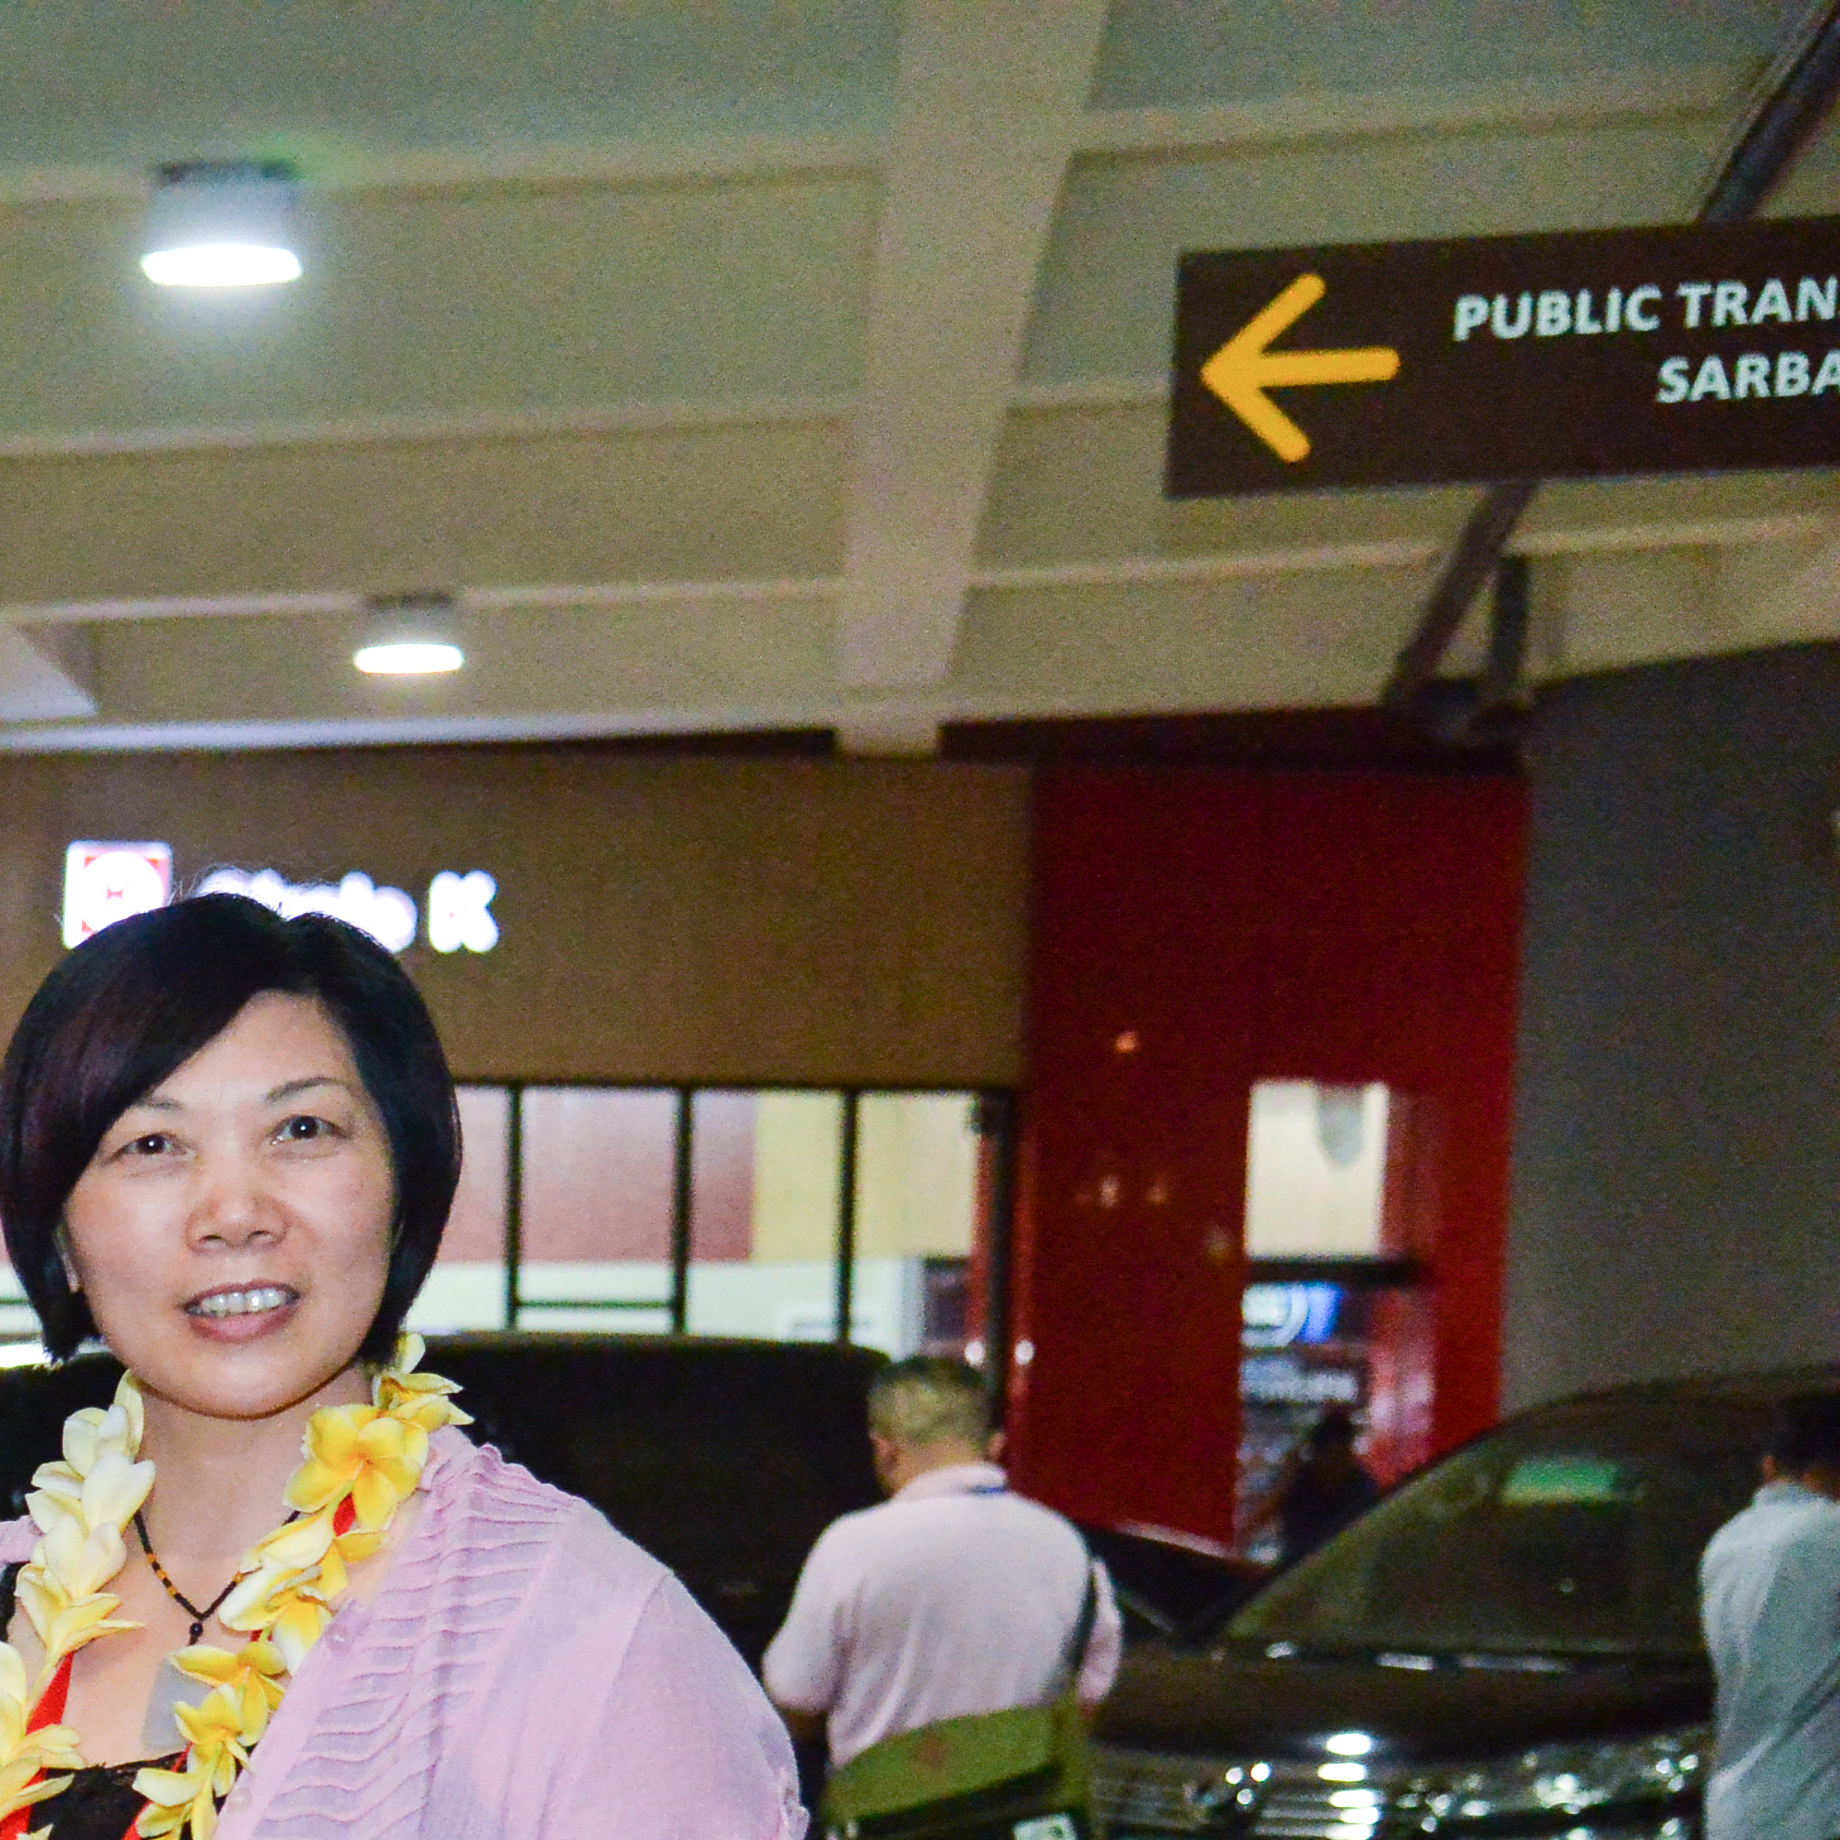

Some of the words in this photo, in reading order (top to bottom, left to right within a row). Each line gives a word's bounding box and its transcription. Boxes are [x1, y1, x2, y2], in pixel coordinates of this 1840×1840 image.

[1453, 282, 1662, 342] PUBLIC
[1655, 348, 1840, 404] SARBA
[428, 870, 500, 953] K
